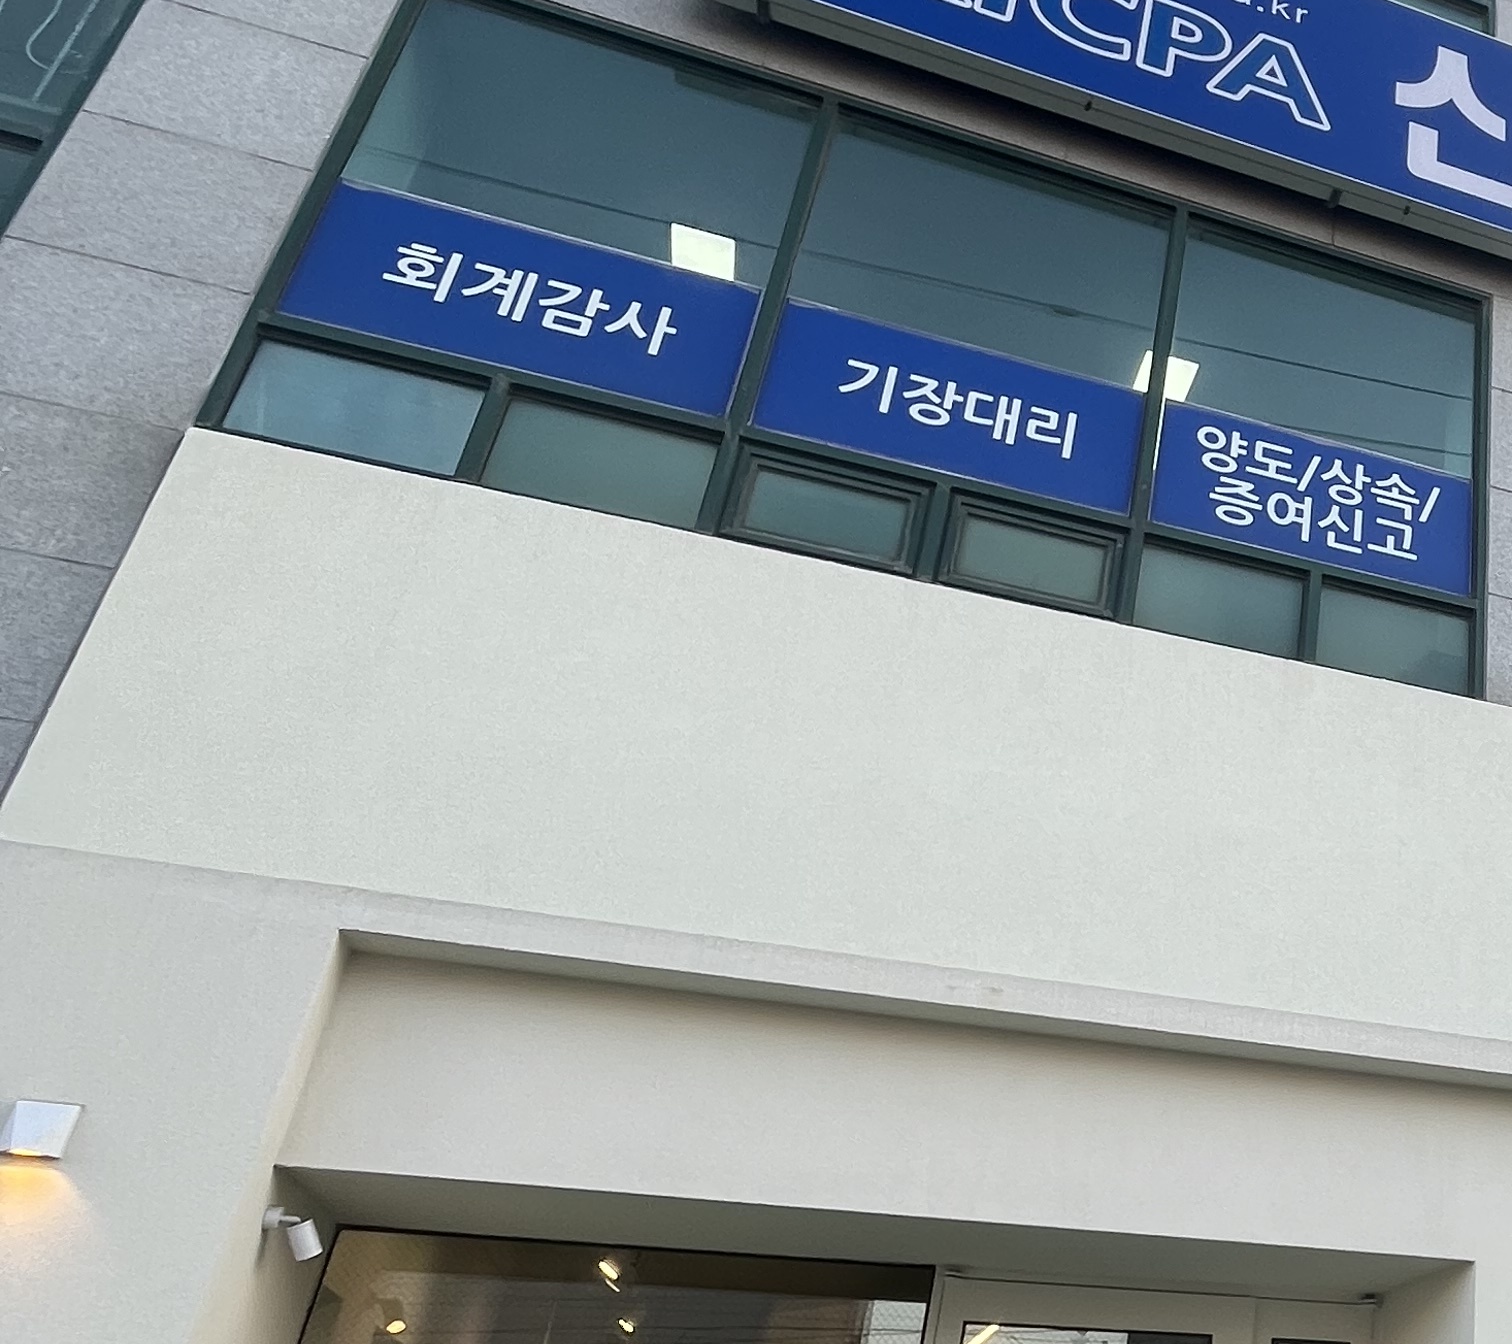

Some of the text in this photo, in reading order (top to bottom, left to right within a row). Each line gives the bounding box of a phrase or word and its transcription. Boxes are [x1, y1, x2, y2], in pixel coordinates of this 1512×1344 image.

[382, 242, 677, 356] 회계감사
[838, 359, 1077, 459] 기장대리
[1197, 425, 1440, 523] 양도/상속/
[1209, 475, 1418, 561] 증여신고
